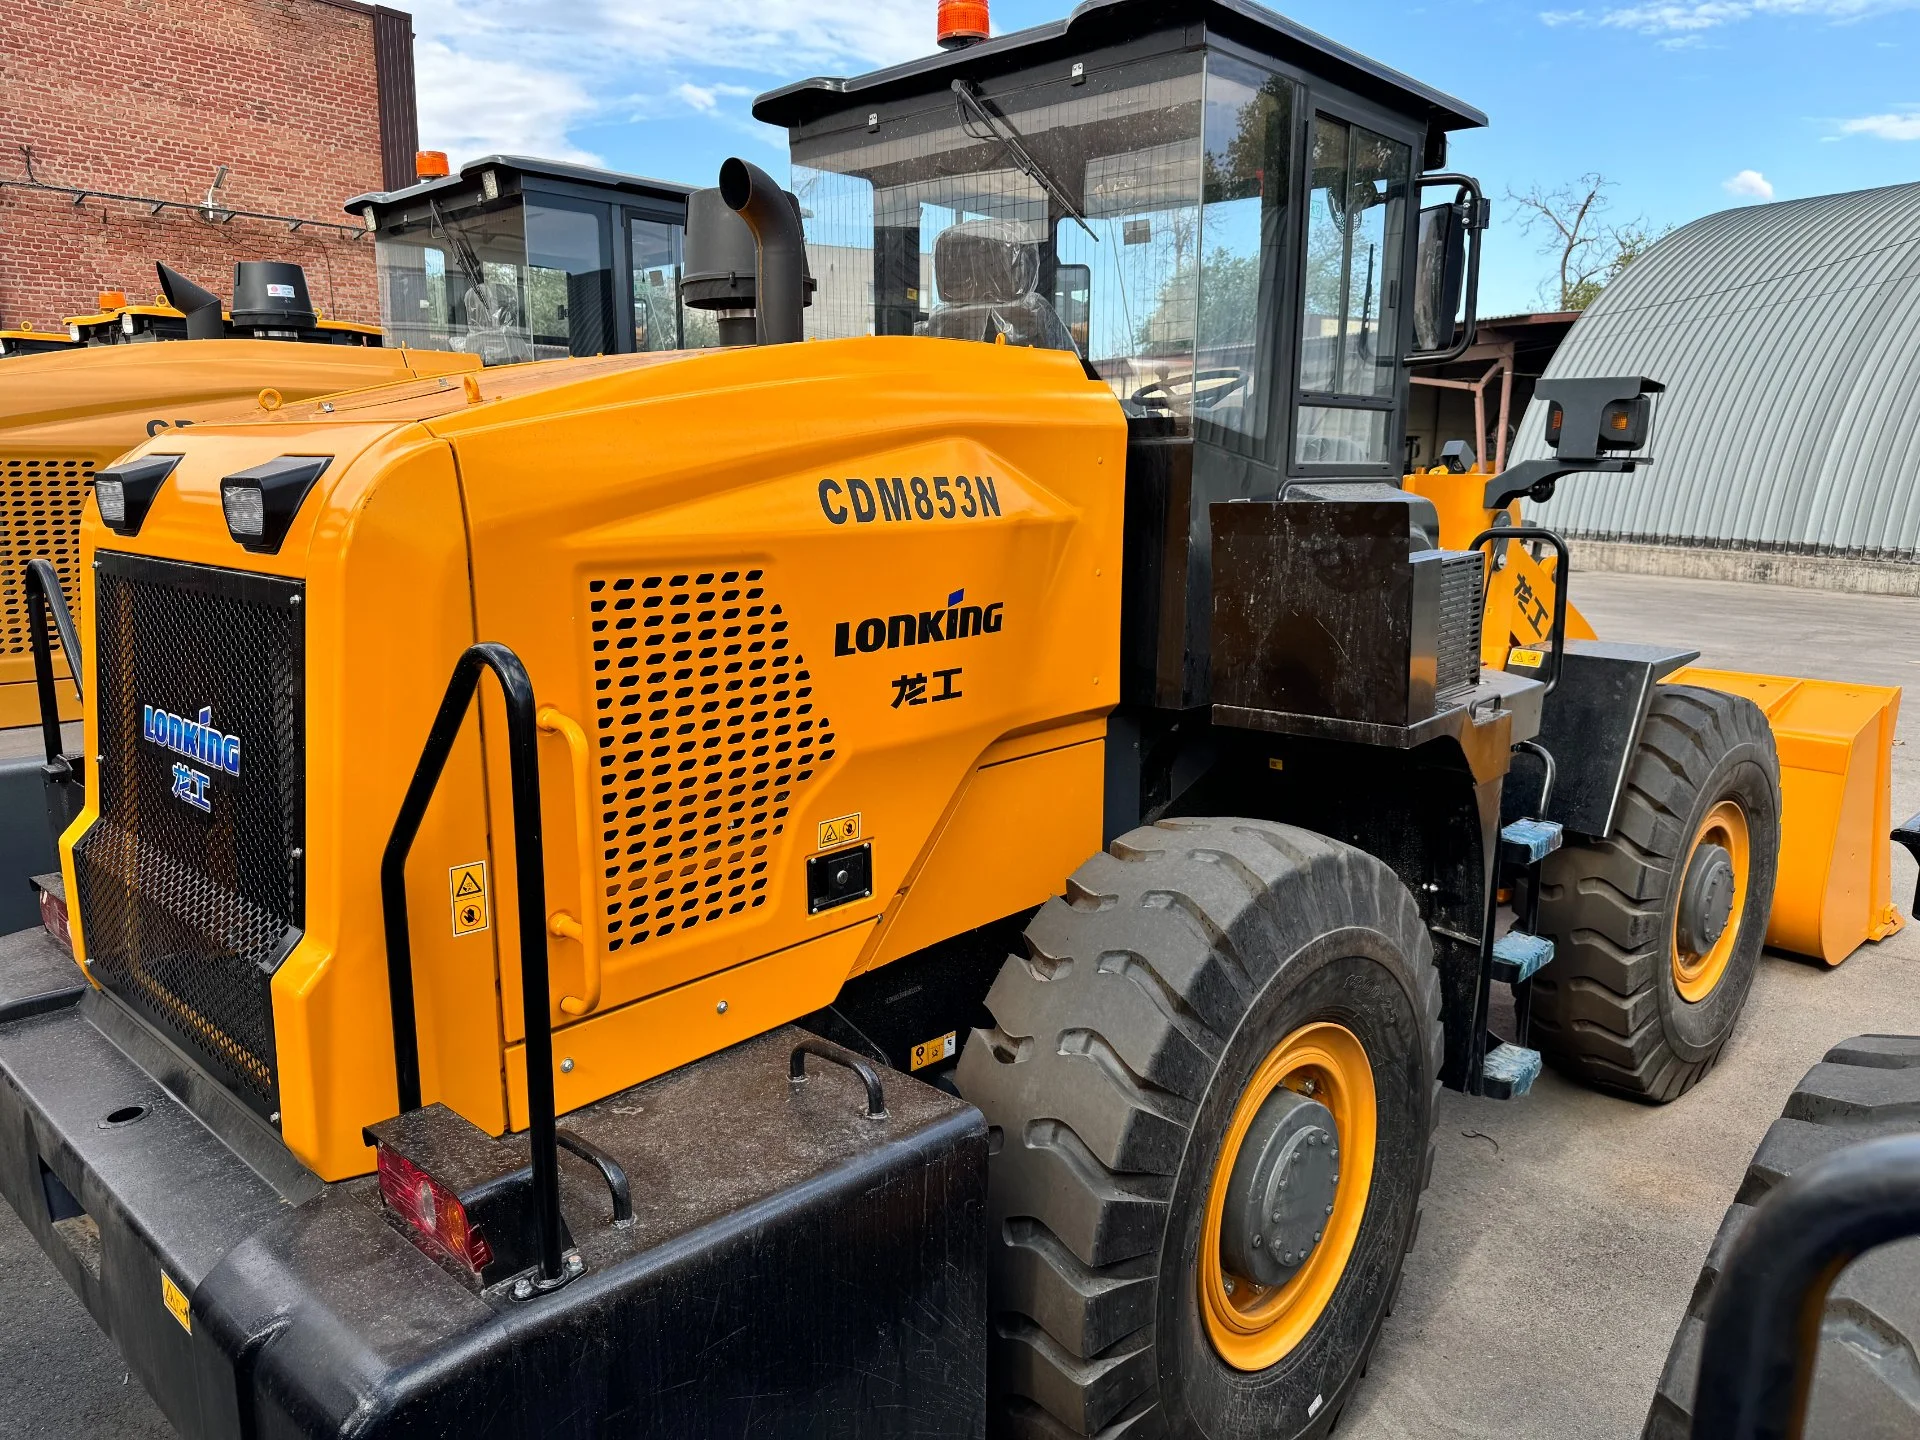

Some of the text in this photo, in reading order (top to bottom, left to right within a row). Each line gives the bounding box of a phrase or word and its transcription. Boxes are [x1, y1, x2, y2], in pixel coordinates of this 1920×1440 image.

[818, 475, 1001, 525] CDM853N
[834, 588, 1004, 657] LONKING
[890, 667, 963, 709] 龙工
[144, 704, 240, 777] LONKING
[171, 762, 211, 813] 龙工
